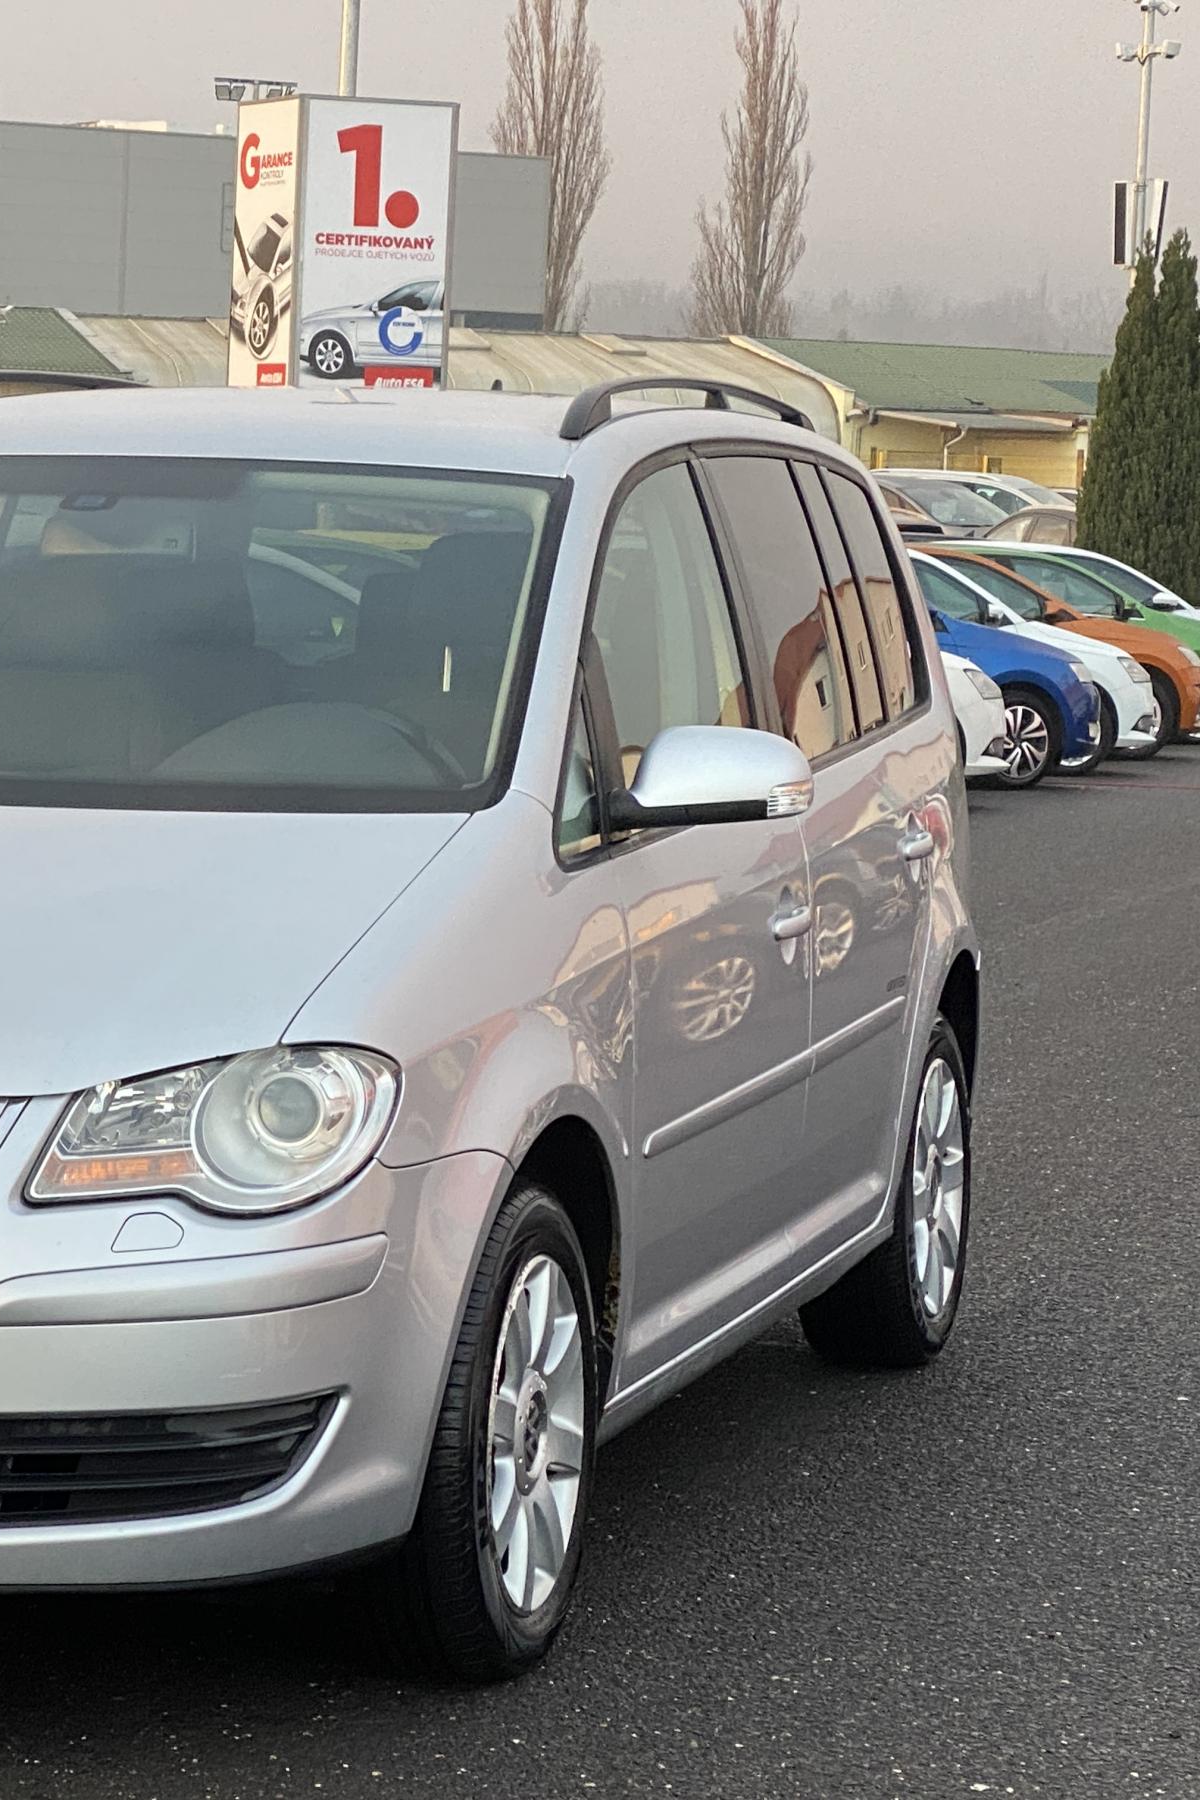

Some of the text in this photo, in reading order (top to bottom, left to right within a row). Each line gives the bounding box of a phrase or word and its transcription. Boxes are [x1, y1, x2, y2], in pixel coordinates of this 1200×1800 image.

[337, 124, 419, 229] 1.
[315, 232, 435, 250] CERTIFIKOVANÝ
[314, 247, 364, 259] PRODEJCE
